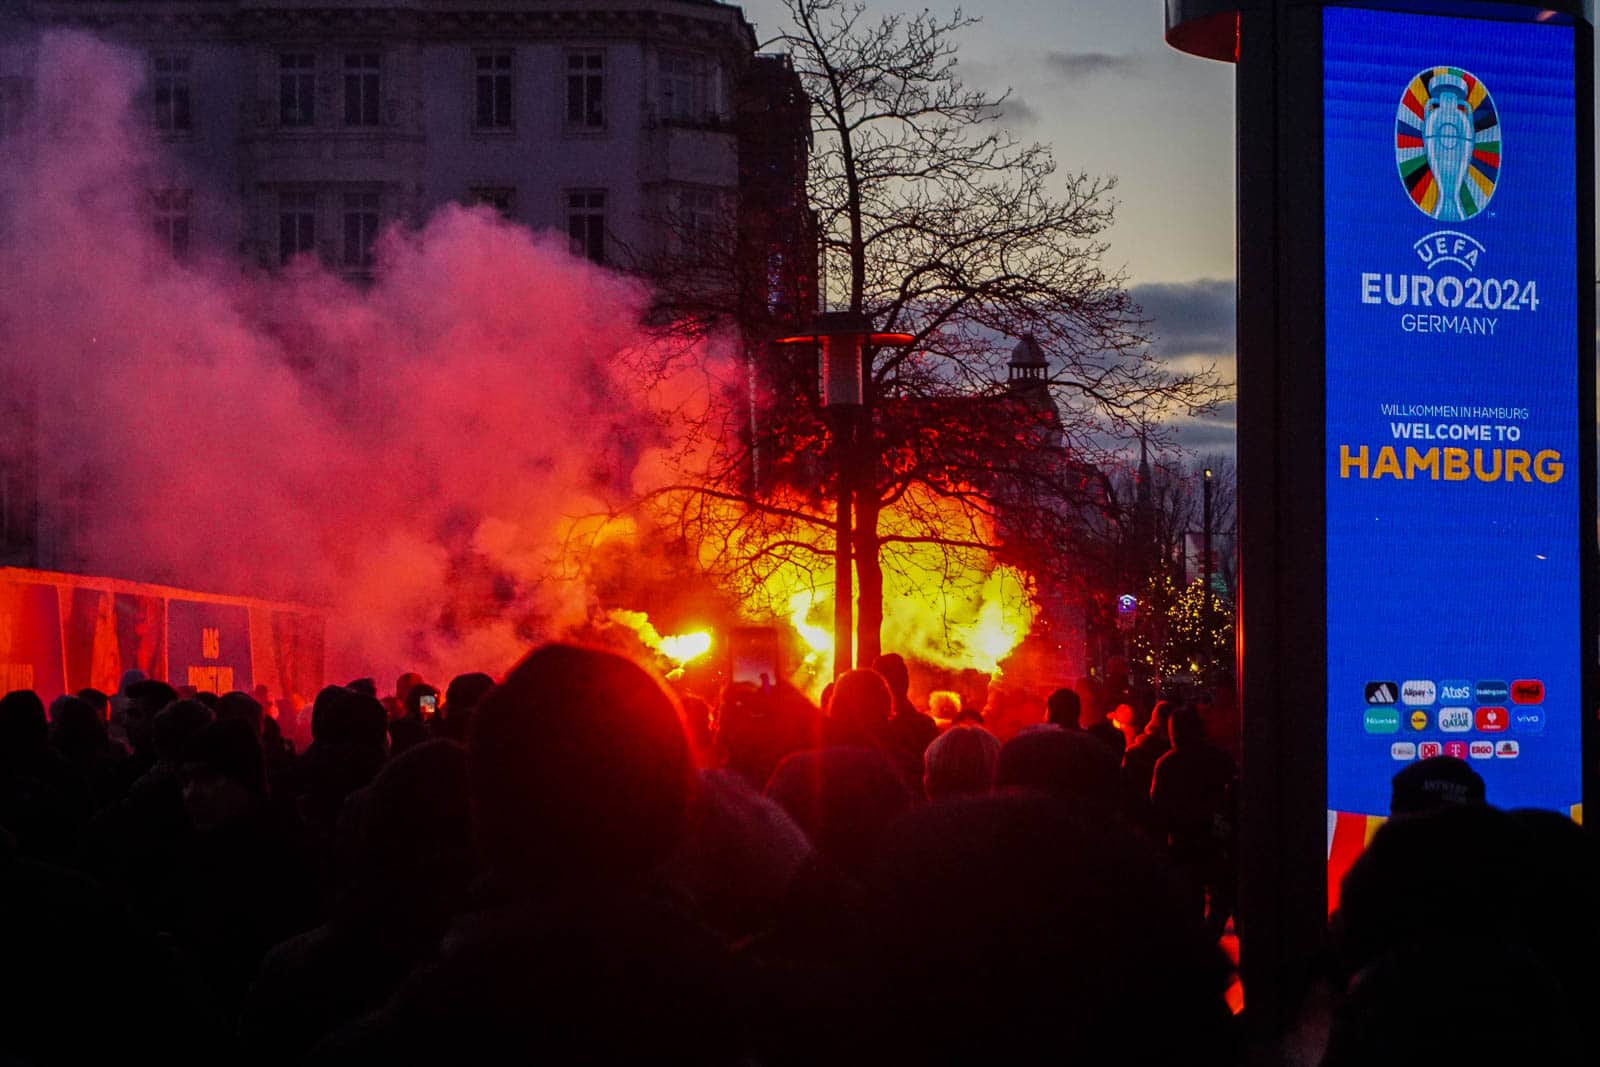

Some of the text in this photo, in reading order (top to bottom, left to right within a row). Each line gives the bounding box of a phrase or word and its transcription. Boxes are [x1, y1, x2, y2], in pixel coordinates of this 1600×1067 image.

[1417, 237, 1479, 266] UEFA
[1361, 272, 1540, 312] EURO2024
[1401, 313, 1498, 335] GERMANY
[1380, 403, 1529, 420] WILLKOMMEN IN HAMBURG
[1391, 422, 1521, 442] WELCOME TO
[1339, 444, 1564, 484] HAMBURG
